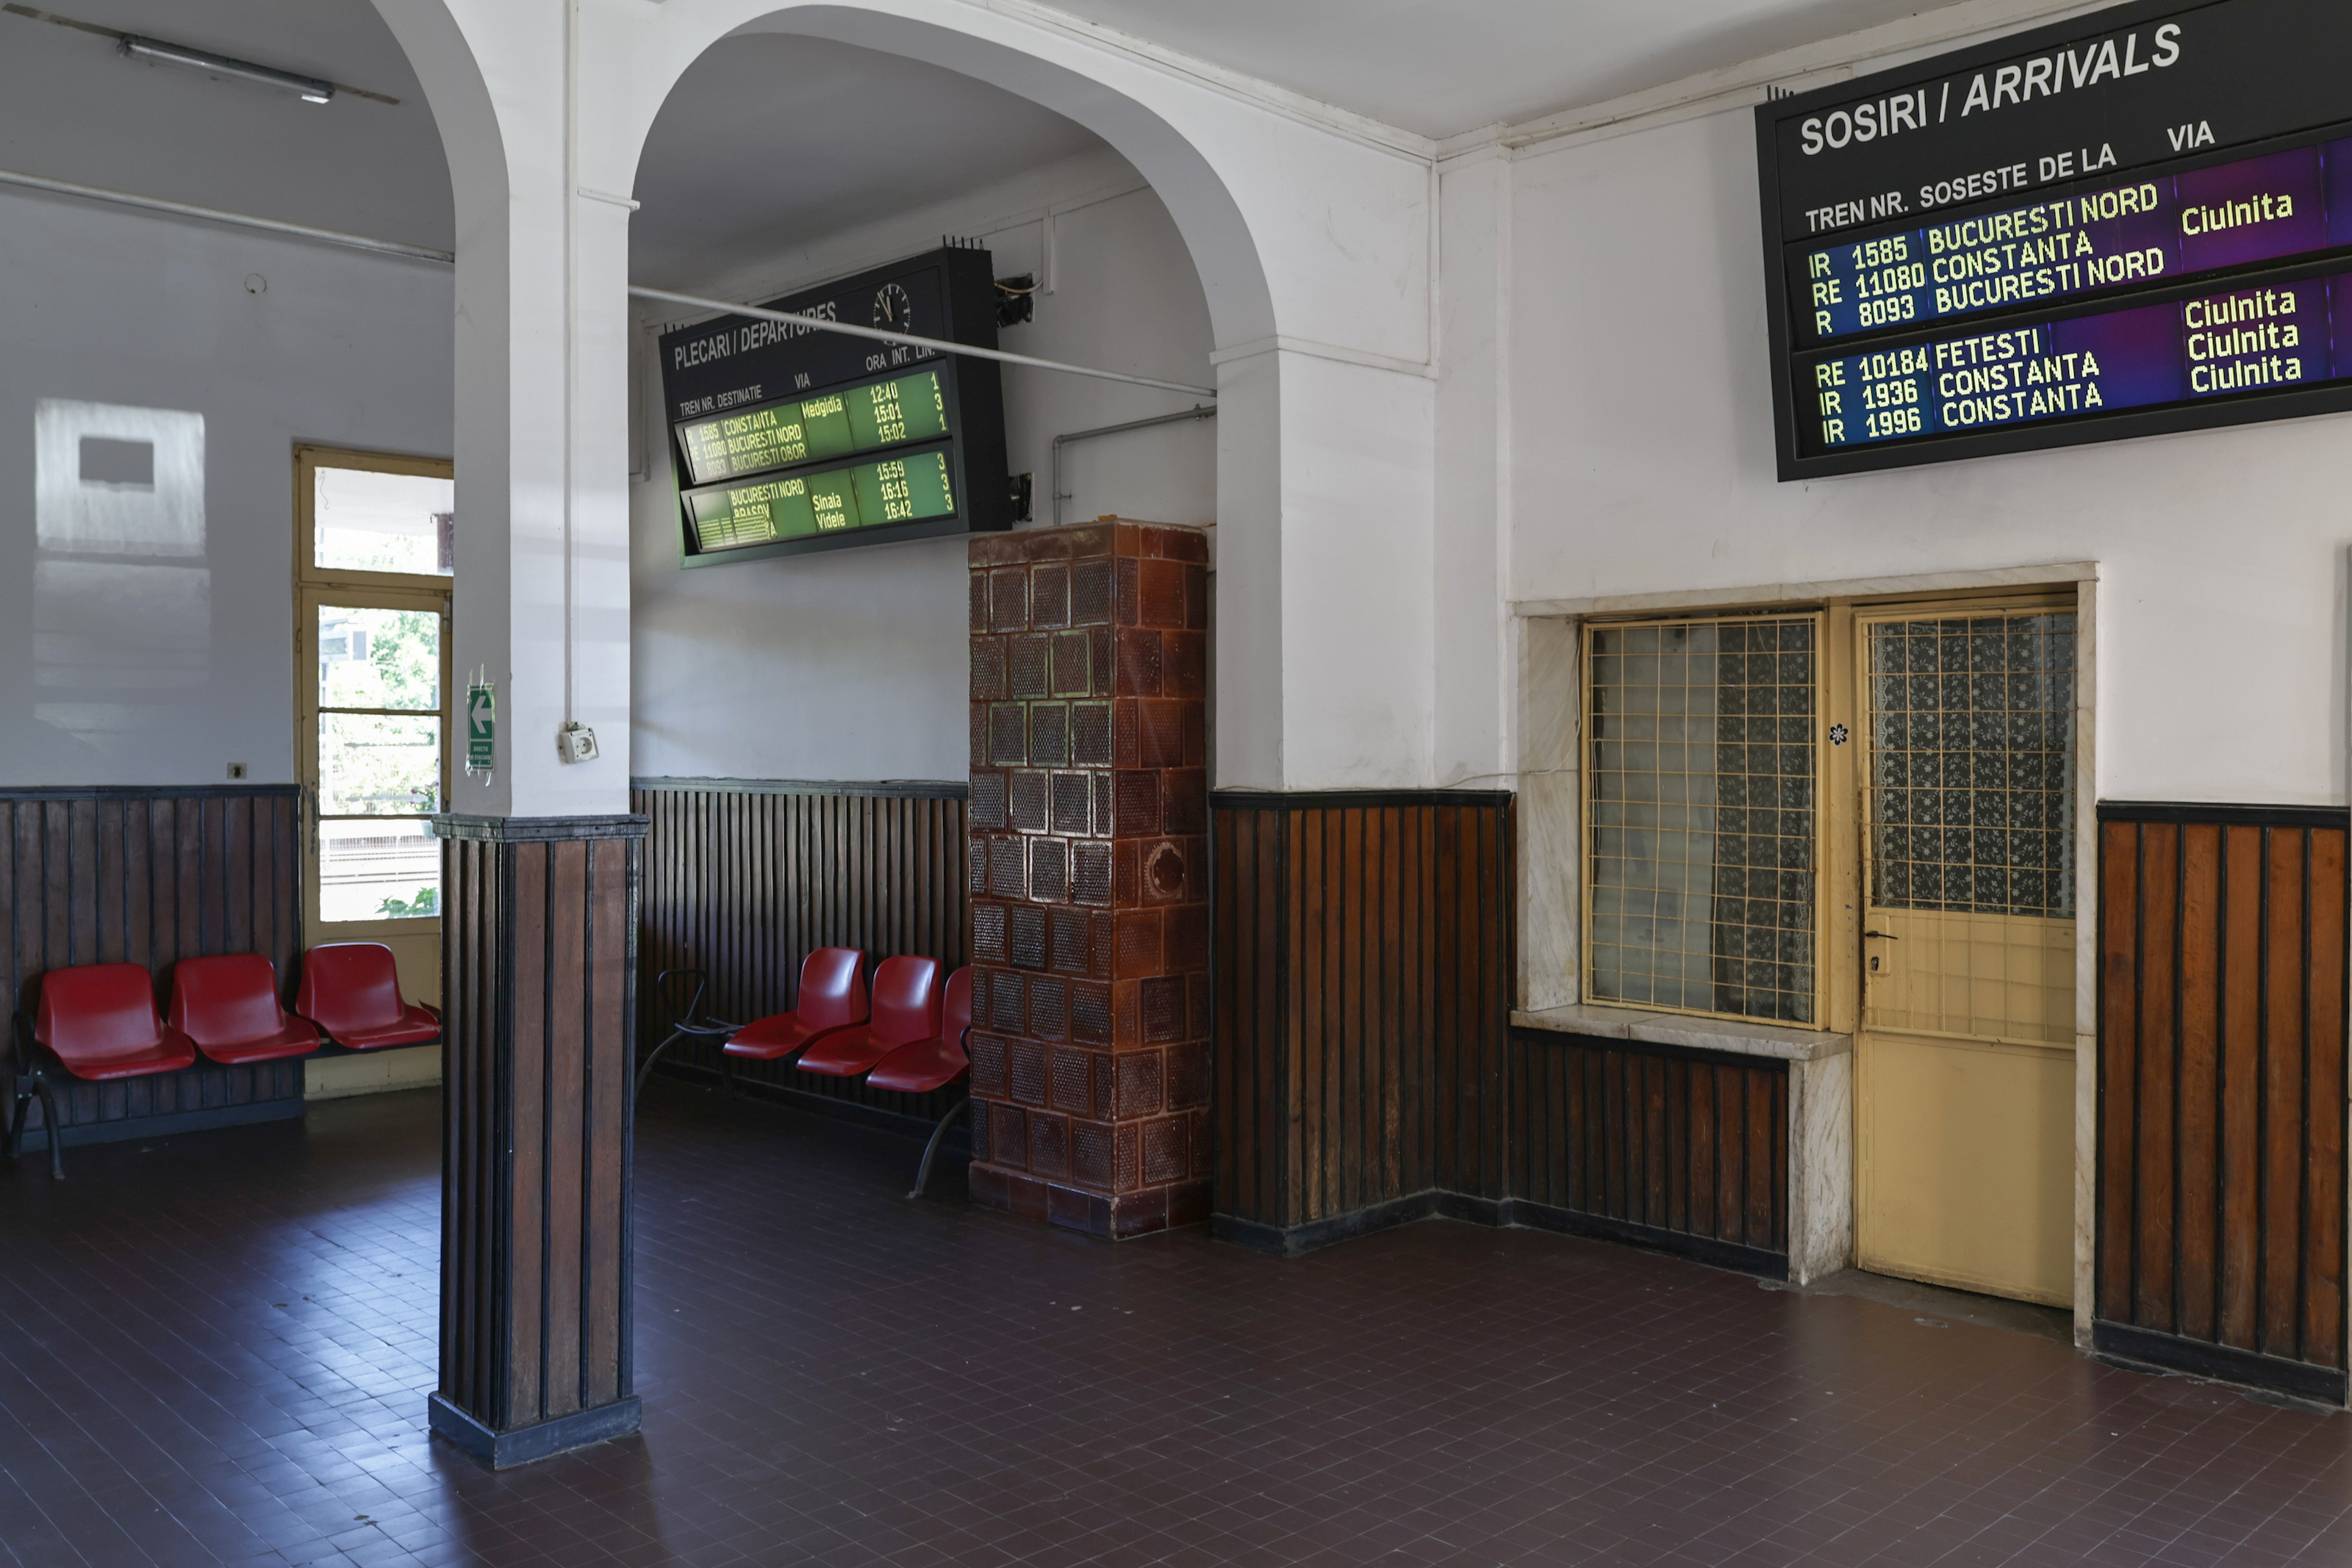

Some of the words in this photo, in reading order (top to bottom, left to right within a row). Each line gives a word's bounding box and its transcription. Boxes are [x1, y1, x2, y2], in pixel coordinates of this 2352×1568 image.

[1801, 89, 1926, 156] SOSIRI
[1938, 82, 1950, 123] /
[1960, 23, 2181, 117] ARRIVALS
[1805, 199, 1865, 233] TREN
[1871, 191, 1909, 219] NR.
[1920, 162, 2028, 208] SOSESTE
[2039, 151, 2074, 181] DE
[2082, 143, 2118, 173] LA
[2167, 121, 2215, 152] VIA
[1809, 252, 1832, 278] IR
[1851, 235, 1908, 270] 1585
[1928, 200, 2074, 254] BUCURESTI
[2081, 183, 2158, 223] NORD
[2181, 193, 2293, 236] Ciulnita
[1813, 278, 1843, 307] RE
[1855, 262, 1926, 298] 11080
[1932, 229, 2093, 283] CONSTANTA
[1815, 310, 1832, 335] R
[1859, 294, 1915, 327] 8093
[1935, 262, 2080, 313] BUCURESTI
[2087, 247, 2165, 287] NORD
[675, 332, 730, 370] PLECARI
[733, 330, 737, 354] /
[1815, 361, 1846, 388] RE
[1859, 347, 1928, 381] 10184
[1935, 328, 2040, 369] FETESTI
[2184, 289, 2296, 329] Ciulnita
[1819, 390, 1842, 416] IR
[1862, 378, 1918, 409] 1936
[1939, 350, 2100, 398] CONSTANTA
[2188, 322, 2299, 361] Ciulnita
[680, 398, 700, 417] TREN
[702, 395, 715, 411] NR.
[717, 384, 762, 408] DESTINATIE
[795, 372, 811, 389] VIA
[866, 353, 887, 371] ORA
[892, 346, 911, 366] INT.
[699, 423, 720, 442] 1585
[724, 410, 778, 436] CONSTANTA
[801, 395, 843, 420] Medgidia
[870, 381, 898, 403] 12:40
[931, 372, 939, 390] 1
[1823, 419, 1846, 444] IR
[1865, 407, 1921, 438] 1996
[1943, 381, 2103, 427] CONSTANTA
[2190, 355, 2301, 393] Ciulnita
[703, 439, 727, 459] 11080
[728, 428, 775, 454] BUCURESTI
[776, 423, 802, 444] NORD
[874, 402, 903, 423] 15:01
[934, 392, 943, 411] 3
[706, 458, 727, 477] 8093
[731, 447, 779, 472] BUCURESTI
[781, 442, 806, 463] OBOR
[878, 421, 906, 443] 15:02
[939, 413, 947, 431] 1
[730, 481, 779, 507] BUCURESTI
[779, 478, 805, 500] NORD
[877, 460, 905, 481] 15:59
[937, 453, 945, 470] 3
[812, 492, 842, 512] Sinaia
[881, 480, 908, 500] 16:16
[941, 472, 950, 491] 3
[816, 511, 846, 530] Videle
[884, 500, 913, 520] 16:42
[944, 493, 953, 511] 3
